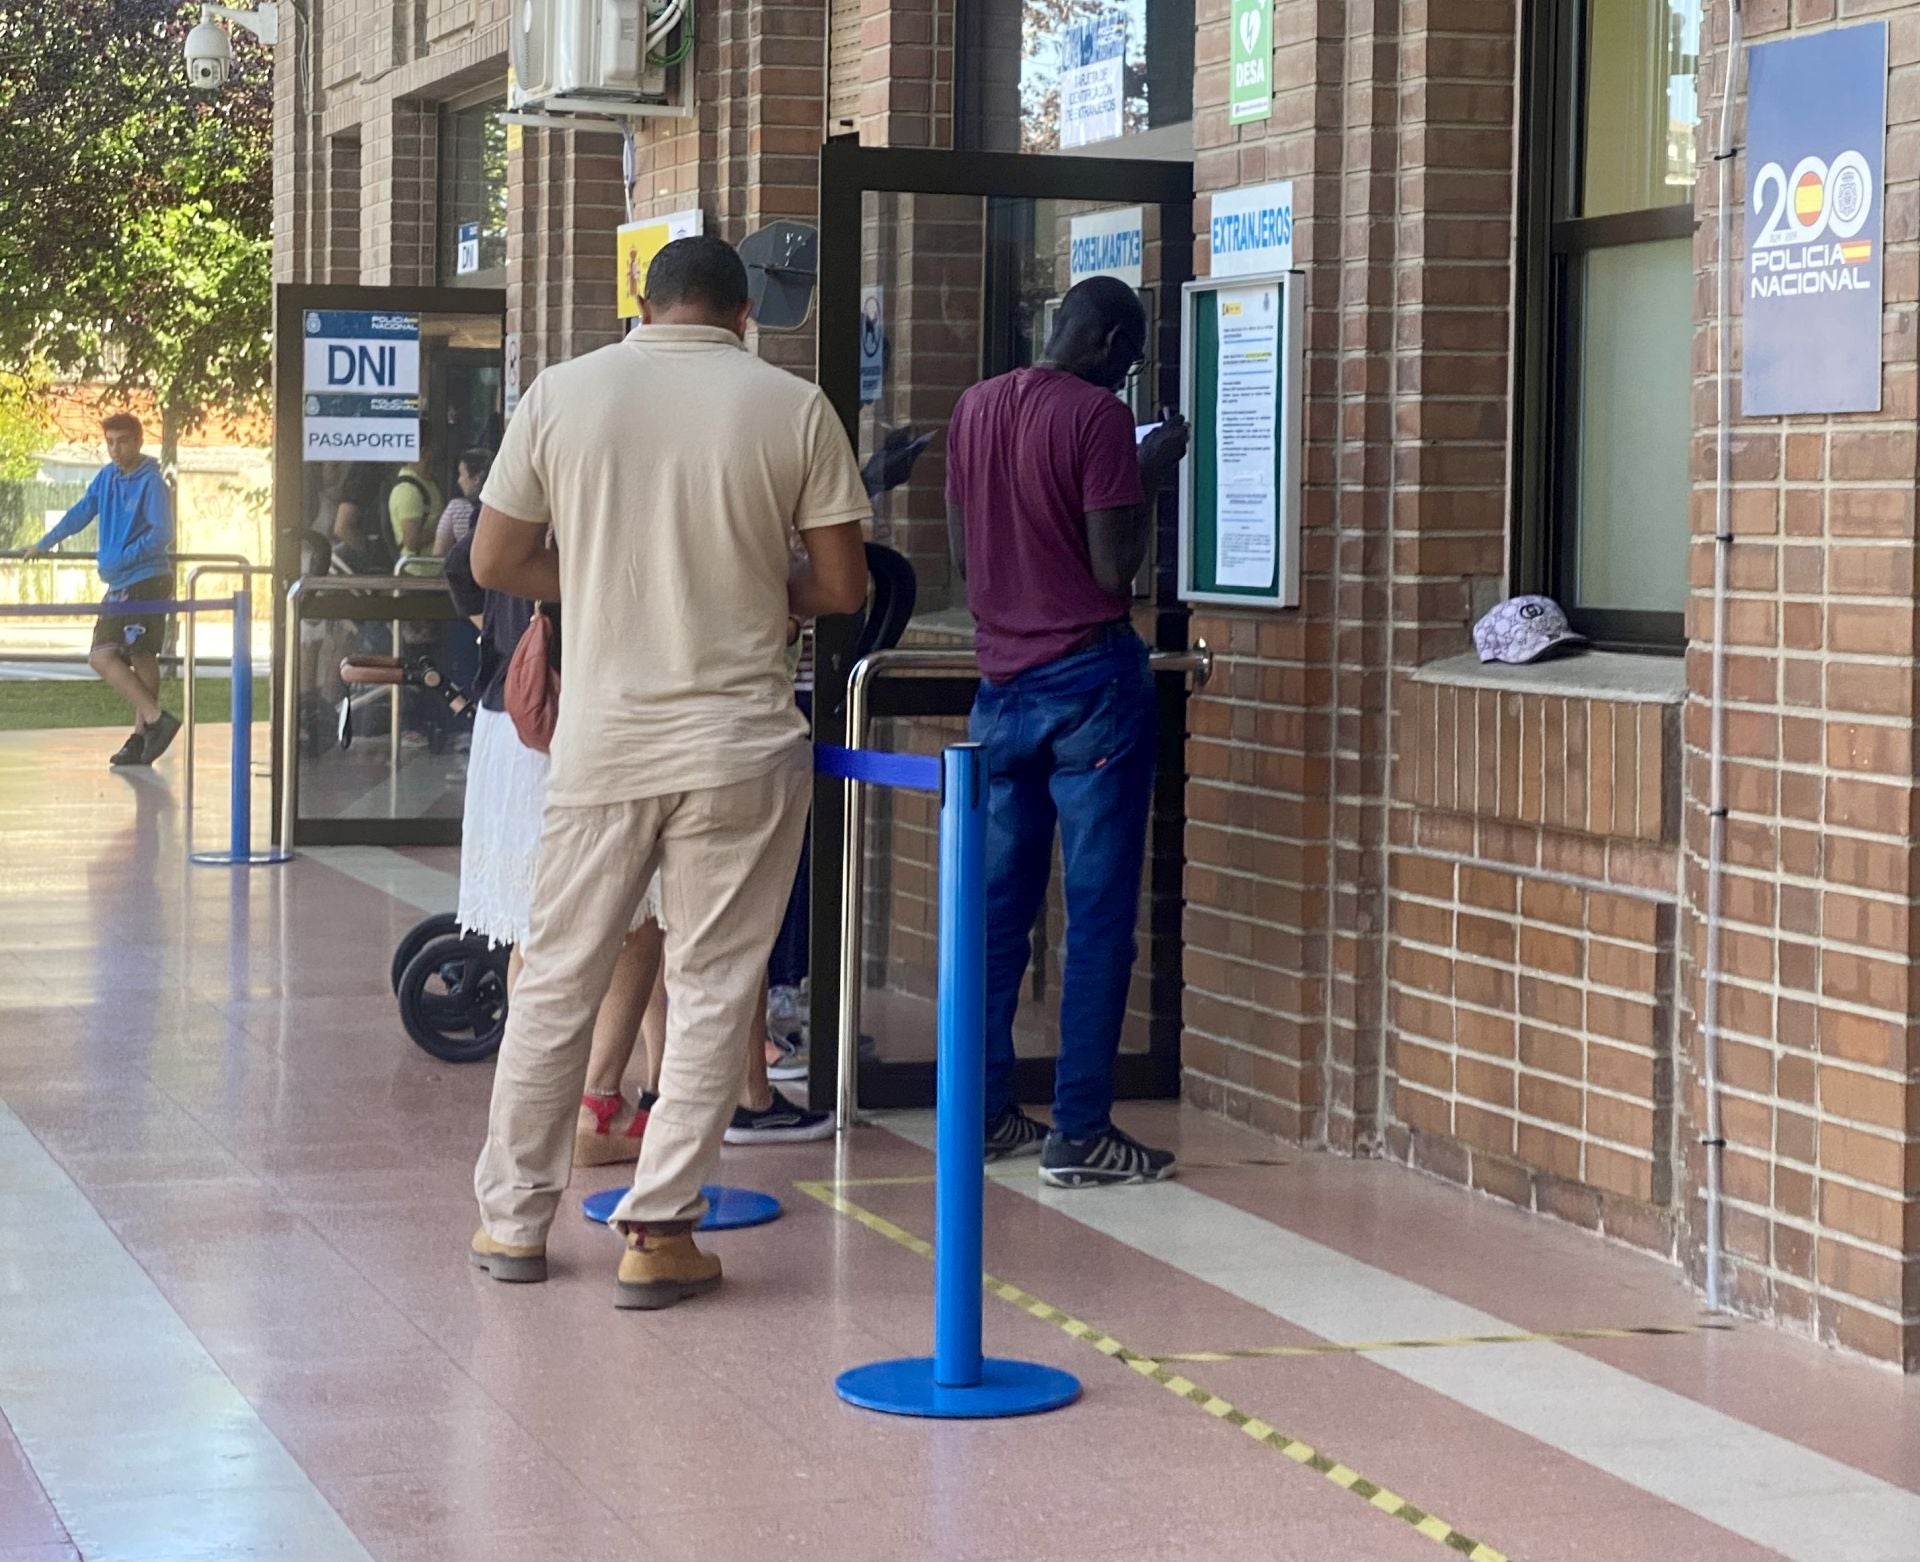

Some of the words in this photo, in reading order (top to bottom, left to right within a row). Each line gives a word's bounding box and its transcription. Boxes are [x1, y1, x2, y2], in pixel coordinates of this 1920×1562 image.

[1235, 58, 1265, 88] DESA
[1213, 206, 1290, 254] EXTRANJEROS
[1751, 267, 1871, 299] NACIONAL
[371, 322, 418, 330] NACIONAL
[328, 345, 396, 386] DNI
[309, 432, 416, 448] PASAPORTE
